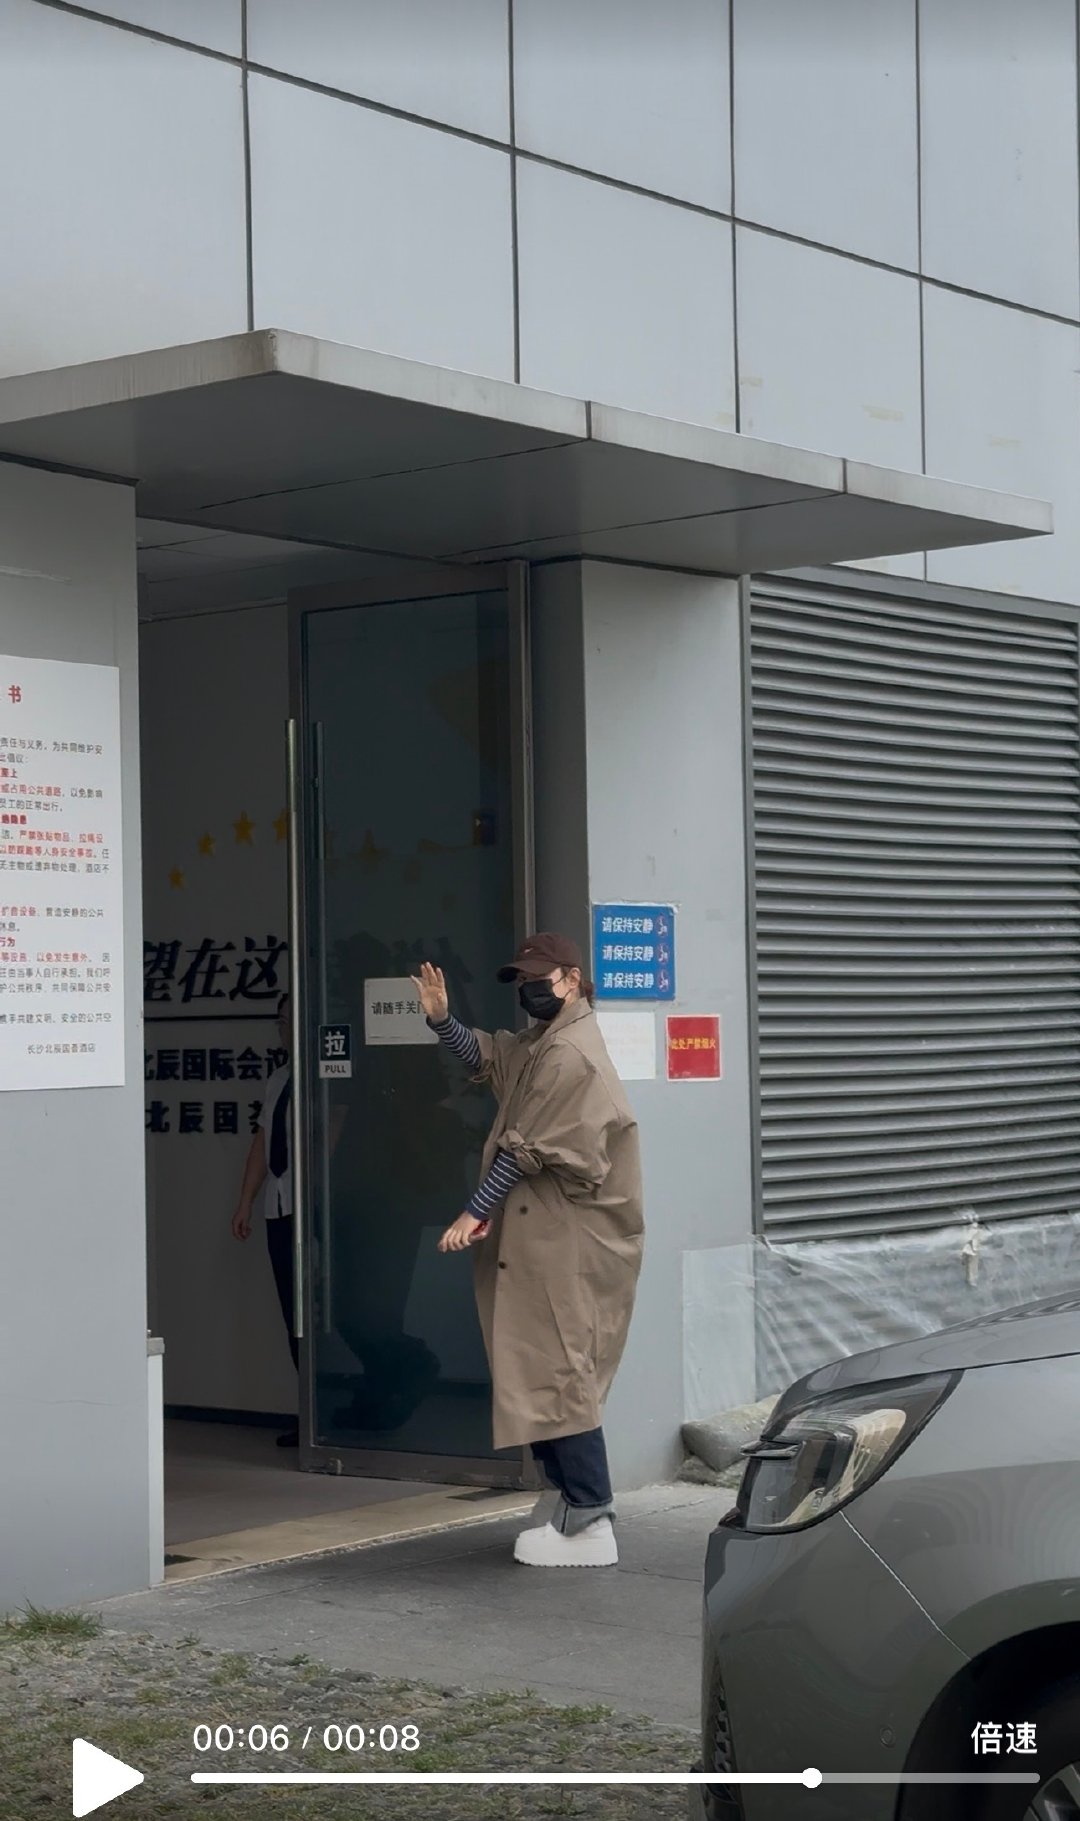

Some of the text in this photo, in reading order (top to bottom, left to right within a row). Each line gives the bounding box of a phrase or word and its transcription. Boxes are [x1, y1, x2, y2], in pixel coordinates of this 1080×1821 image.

[8, 685, 21, 703] 书
[602, 917, 654, 933] 请保持安静
[602, 945, 654, 962] 请保持安静
[603, 972, 655, 989] 请保持安静
[324, 1030, 346, 1057] 拉
[325, 1065, 346, 1074] PULL
